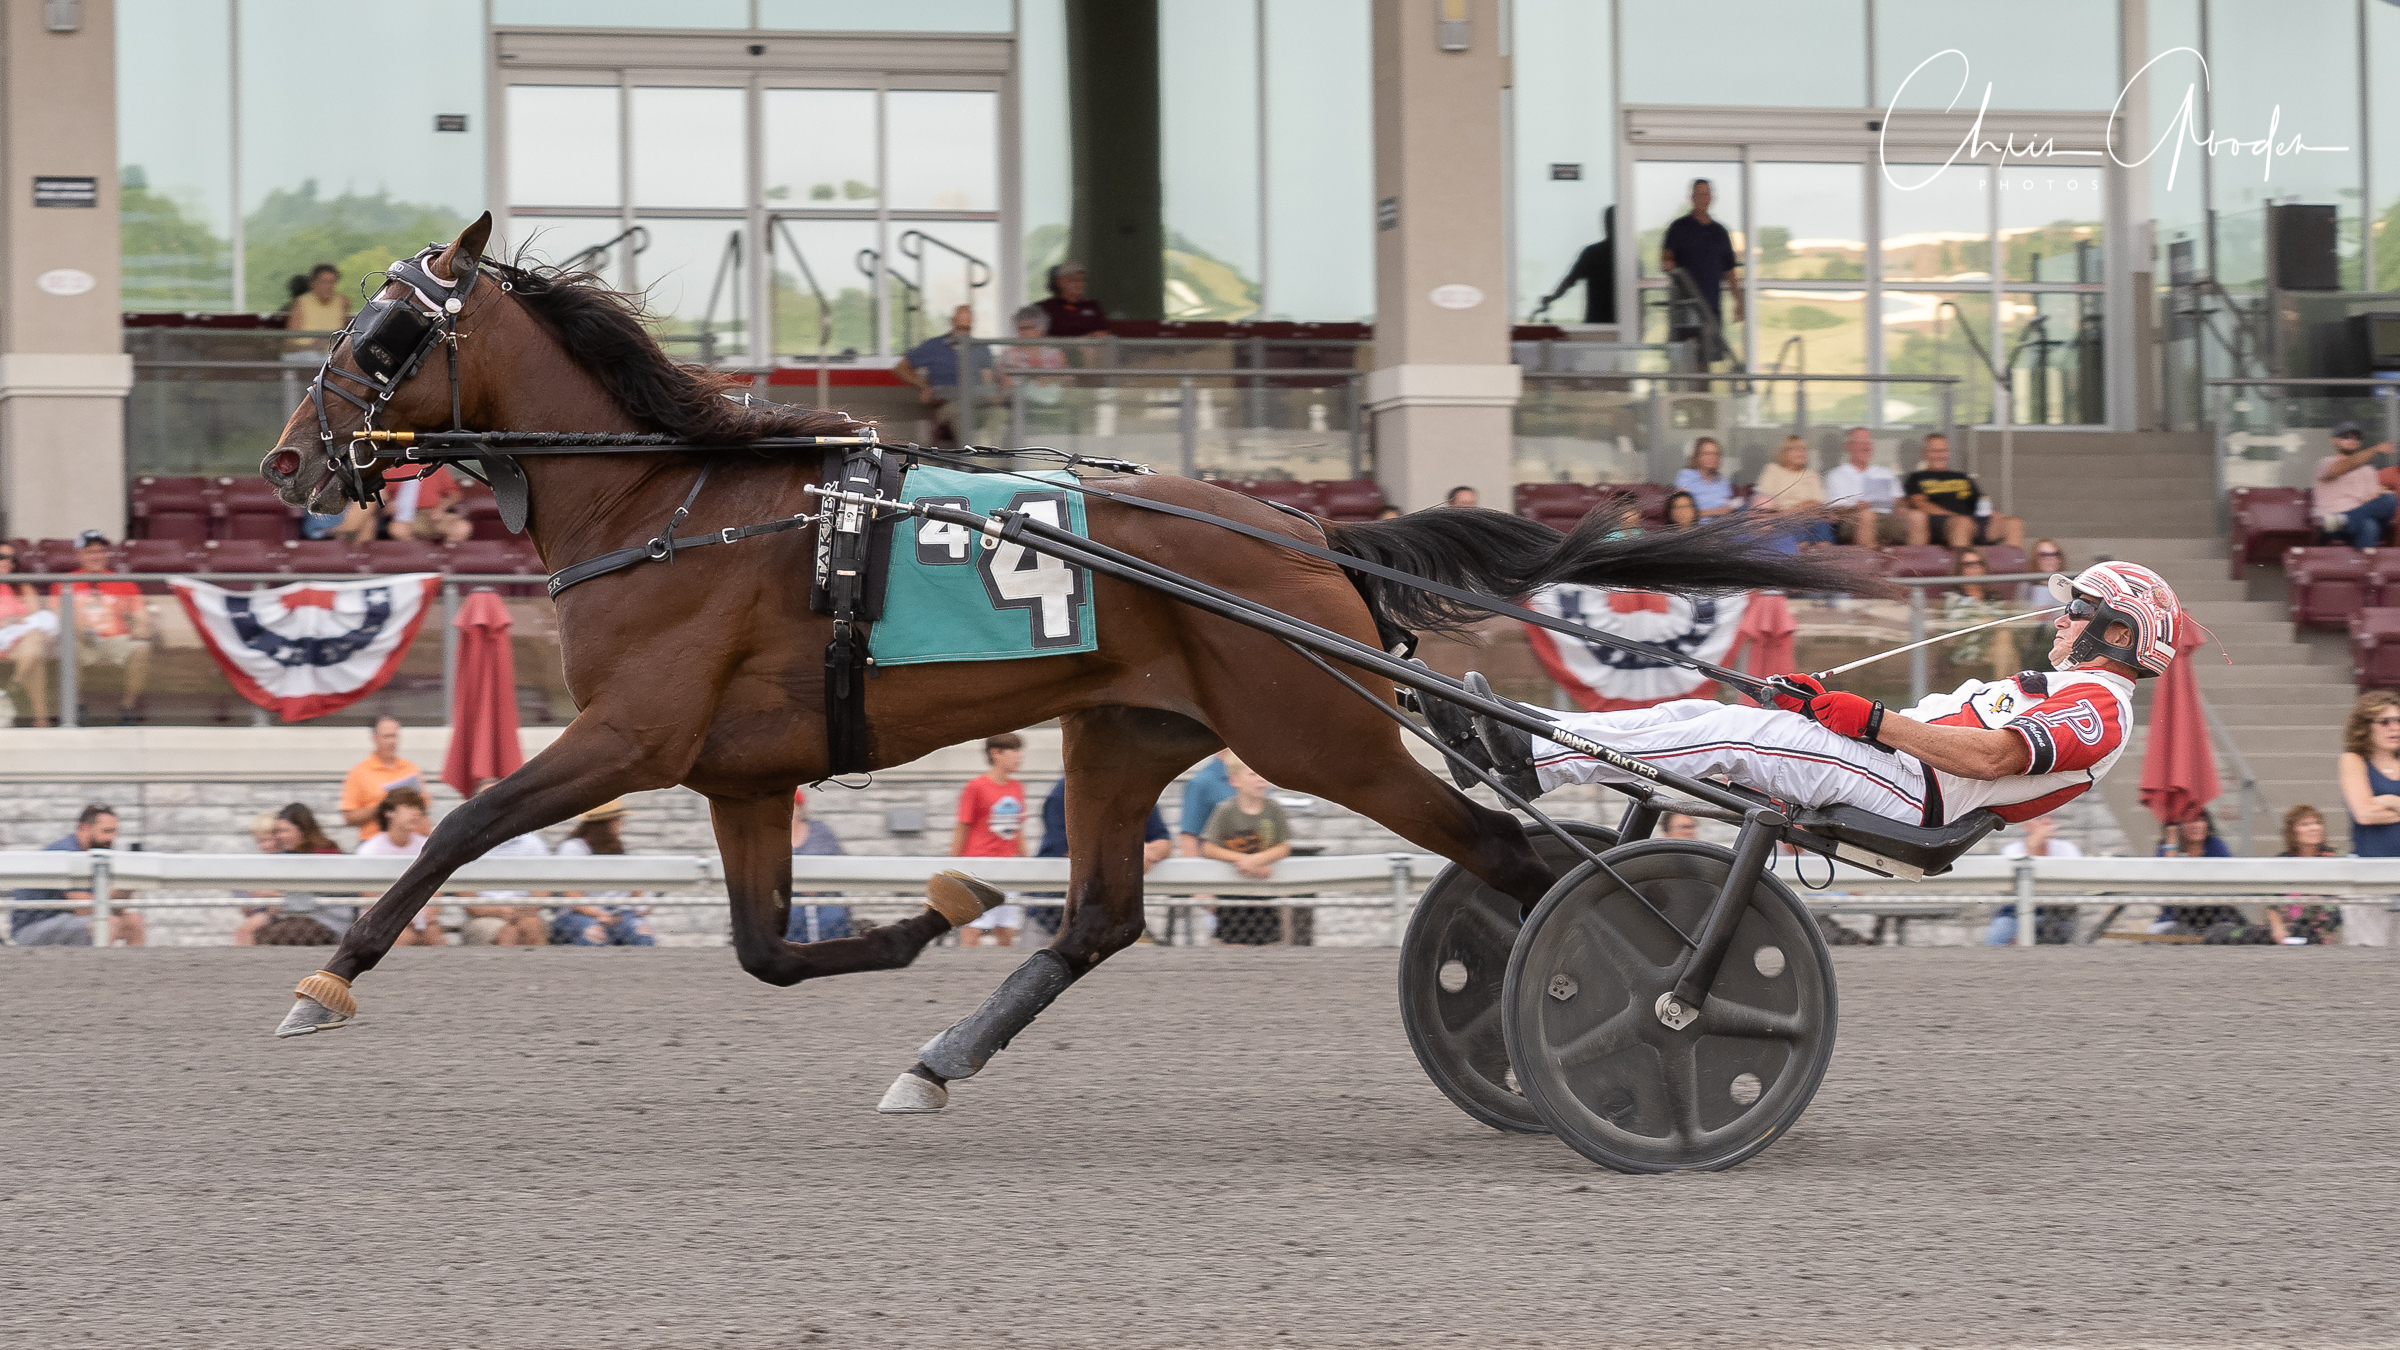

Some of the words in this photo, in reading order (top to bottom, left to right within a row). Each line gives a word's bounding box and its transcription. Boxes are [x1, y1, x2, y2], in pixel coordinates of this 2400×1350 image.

[919, 502, 970, 559] 4
[989, 499, 1075, 640] 4
[2033, 698, 2105, 746] P
[1552, 728, 1604, 757] NANCY
[1605, 749, 1659, 779] TAKTER
